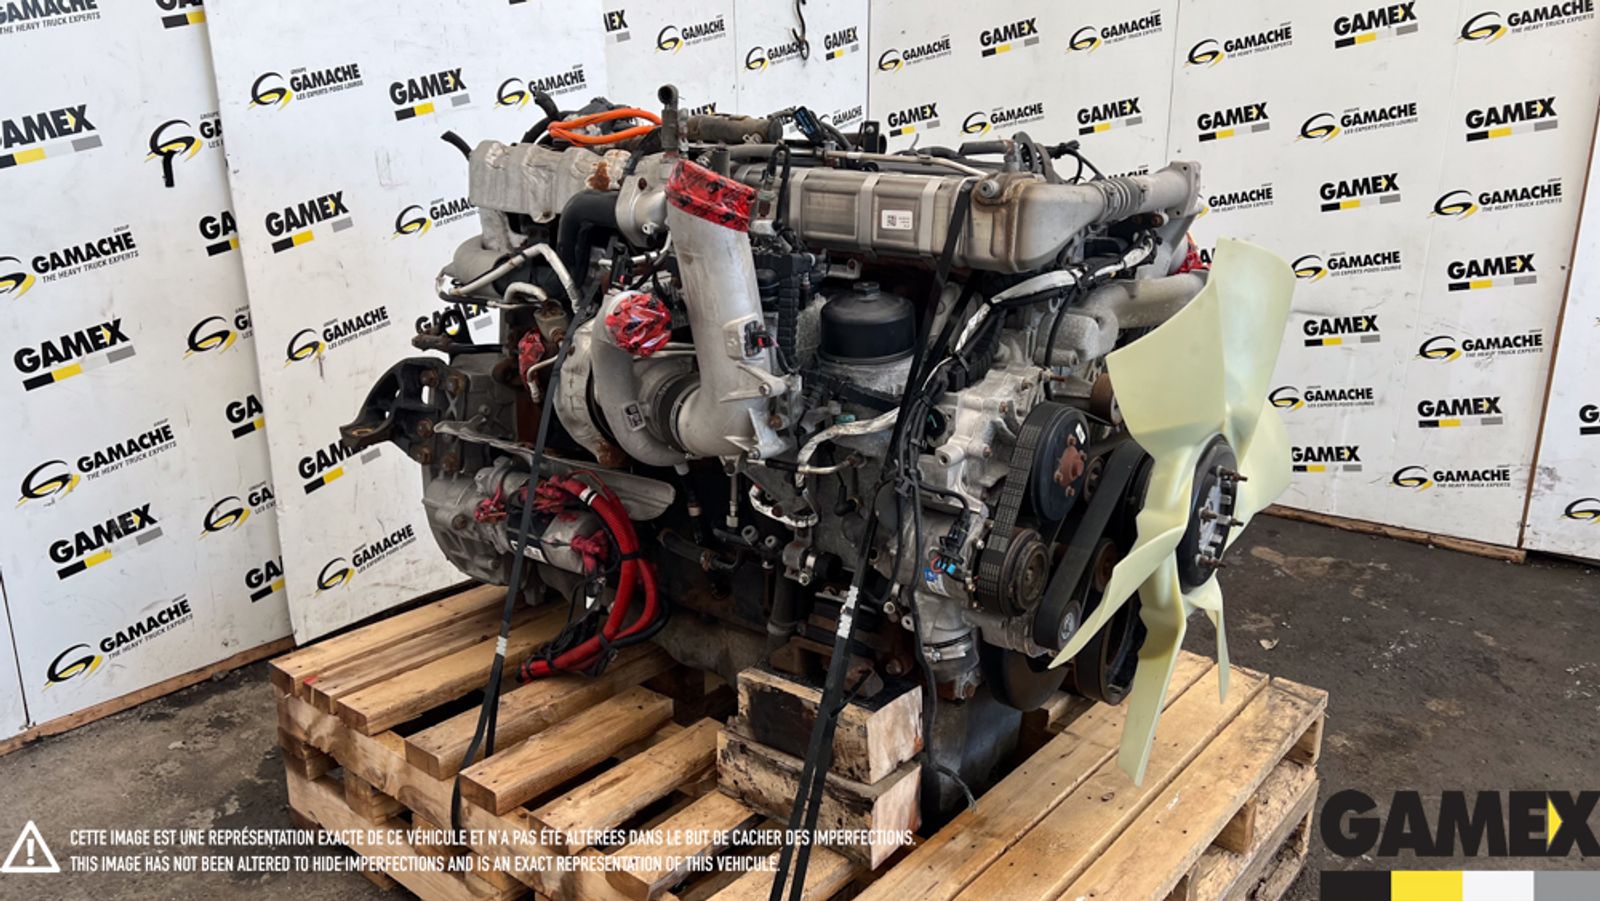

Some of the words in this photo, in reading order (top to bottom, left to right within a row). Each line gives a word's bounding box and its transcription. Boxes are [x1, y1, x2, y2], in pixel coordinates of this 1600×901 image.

[1334, 1, 1417, 36] GAMEX
[1507, 0, 1594, 26] GAMACHE
[681, 19, 725, 40] GAMACHE
[825, 26, 859, 50] GAMEX
[980, 18, 1038, 46] GAMEX
[1101, 14, 1162, 39] GAMACHE
[1224, 26, 1292, 52] GAMACHE
[902, 38, 951, 61] GAMACHE
[290, 63, 361, 92] GAMACHE
[390, 68, 467, 105] GAMEX
[528, 69, 585, 94] GAMACHE
[888, 103, 939, 127] GAMEX
[990, 102, 1043, 124] GAMACHE
[1077, 97, 1141, 125] GAMEX
[1197, 102, 1269, 130] GAMEX
[1340, 102, 1417, 128] GAMACHE
[1466, 97, 1556, 129] GAMEX
[0, 105, 96, 148] AMEX
[1208, 187, 1273, 207] GAMACHE
[1320, 173, 1400, 200] GAMEX
[1478, 182, 1562, 206] GAMACHE
[266, 191, 349, 236] GAMEX
[32, 231, 136, 274] GAMACHE
[1327, 251, 1400, 270] GAMACHE
[1448, 254, 1536, 279] GAMEX
[322, 305, 389, 343] GAMACHE
[1304, 315, 1379, 336] GAMEX
[14, 319, 130, 374] GAMEX
[1462, 334, 1542, 352] GAMACHE
[1304, 387, 1373, 402] GAMACHE
[1418, 397, 1502, 417] GAMEX
[77, 424, 175, 473] GAMACHE
[1292, 446, 1361, 462] GAMEX
[1433, 469, 1510, 482] GAMACHE
[50, 502, 157, 564] GAMEX
[352, 524, 415, 568] GAMACHE
[100, 599, 192, 653] GAMACHE
